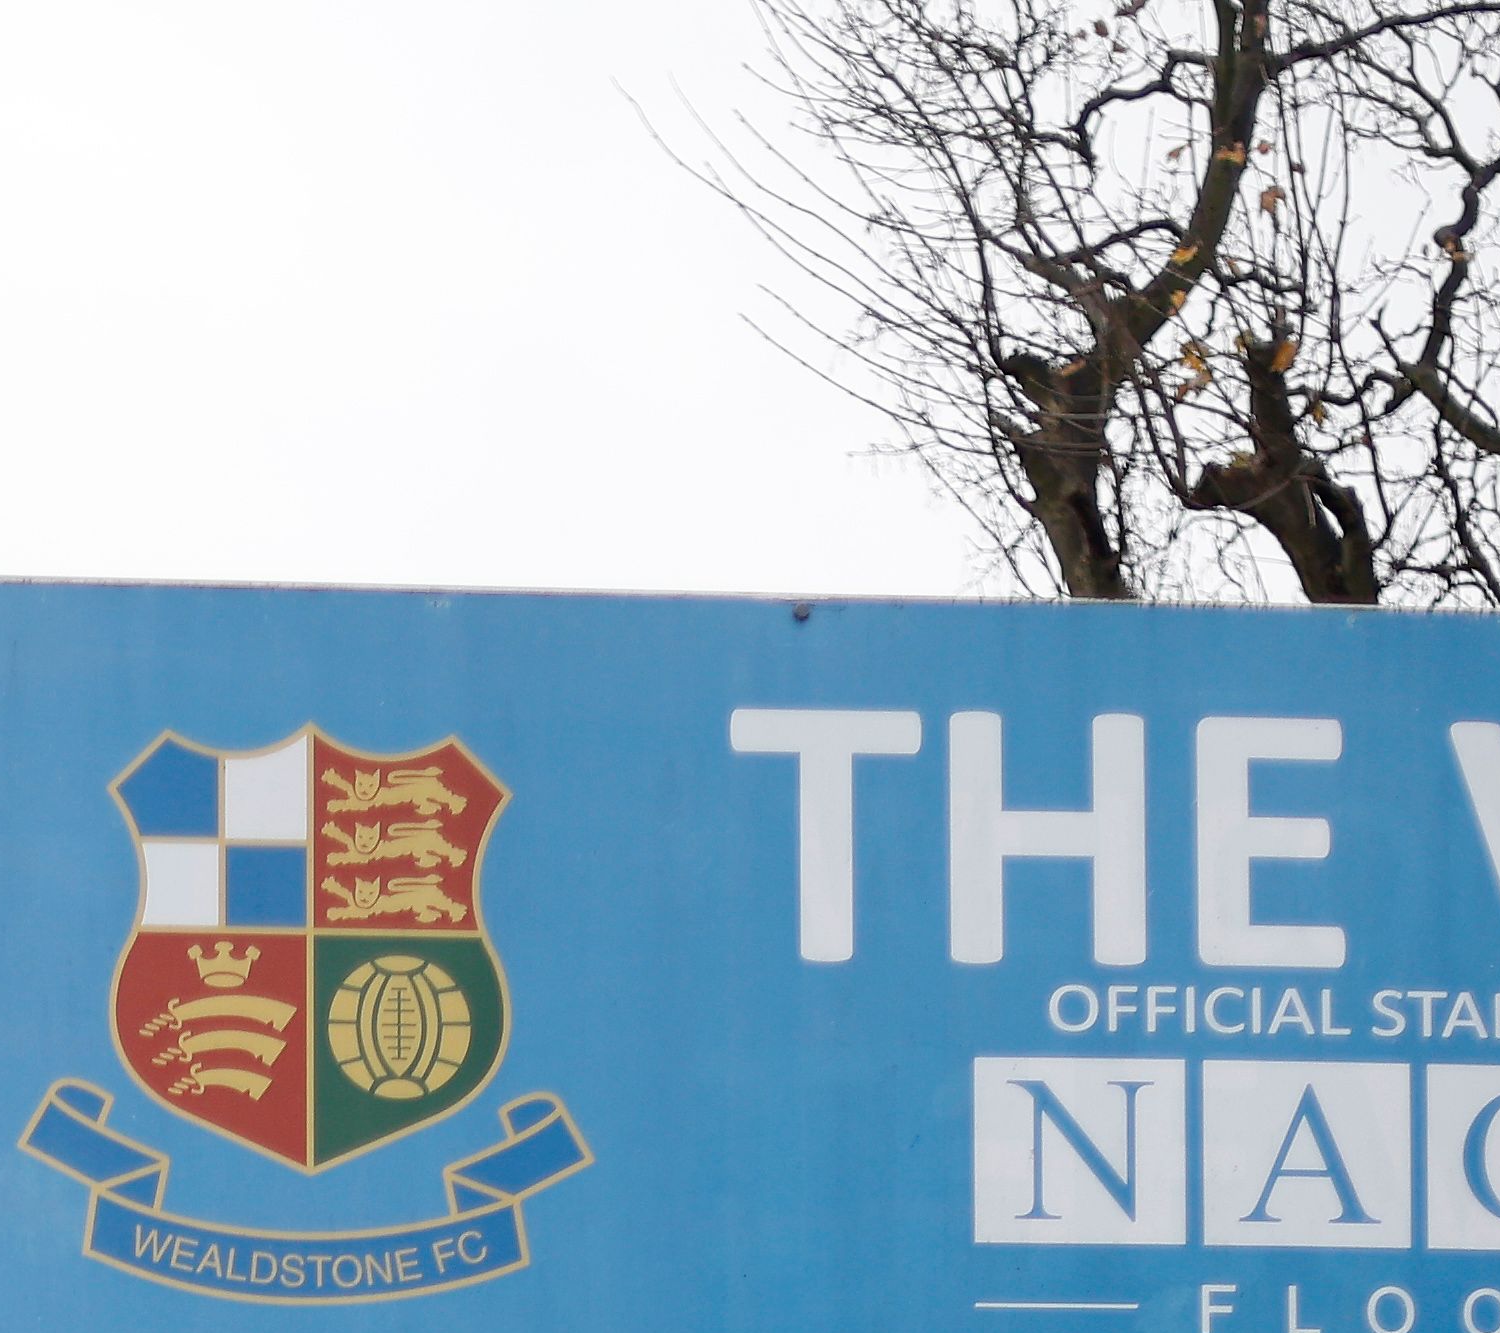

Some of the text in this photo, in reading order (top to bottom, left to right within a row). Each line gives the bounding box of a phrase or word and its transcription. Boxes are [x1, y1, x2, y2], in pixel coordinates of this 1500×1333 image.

[728, 709, 1346, 970] THE
[1047, 983, 1355, 1038] OFFICIAL
[133, 1223, 489, 1290] WEALDSTONE FC
